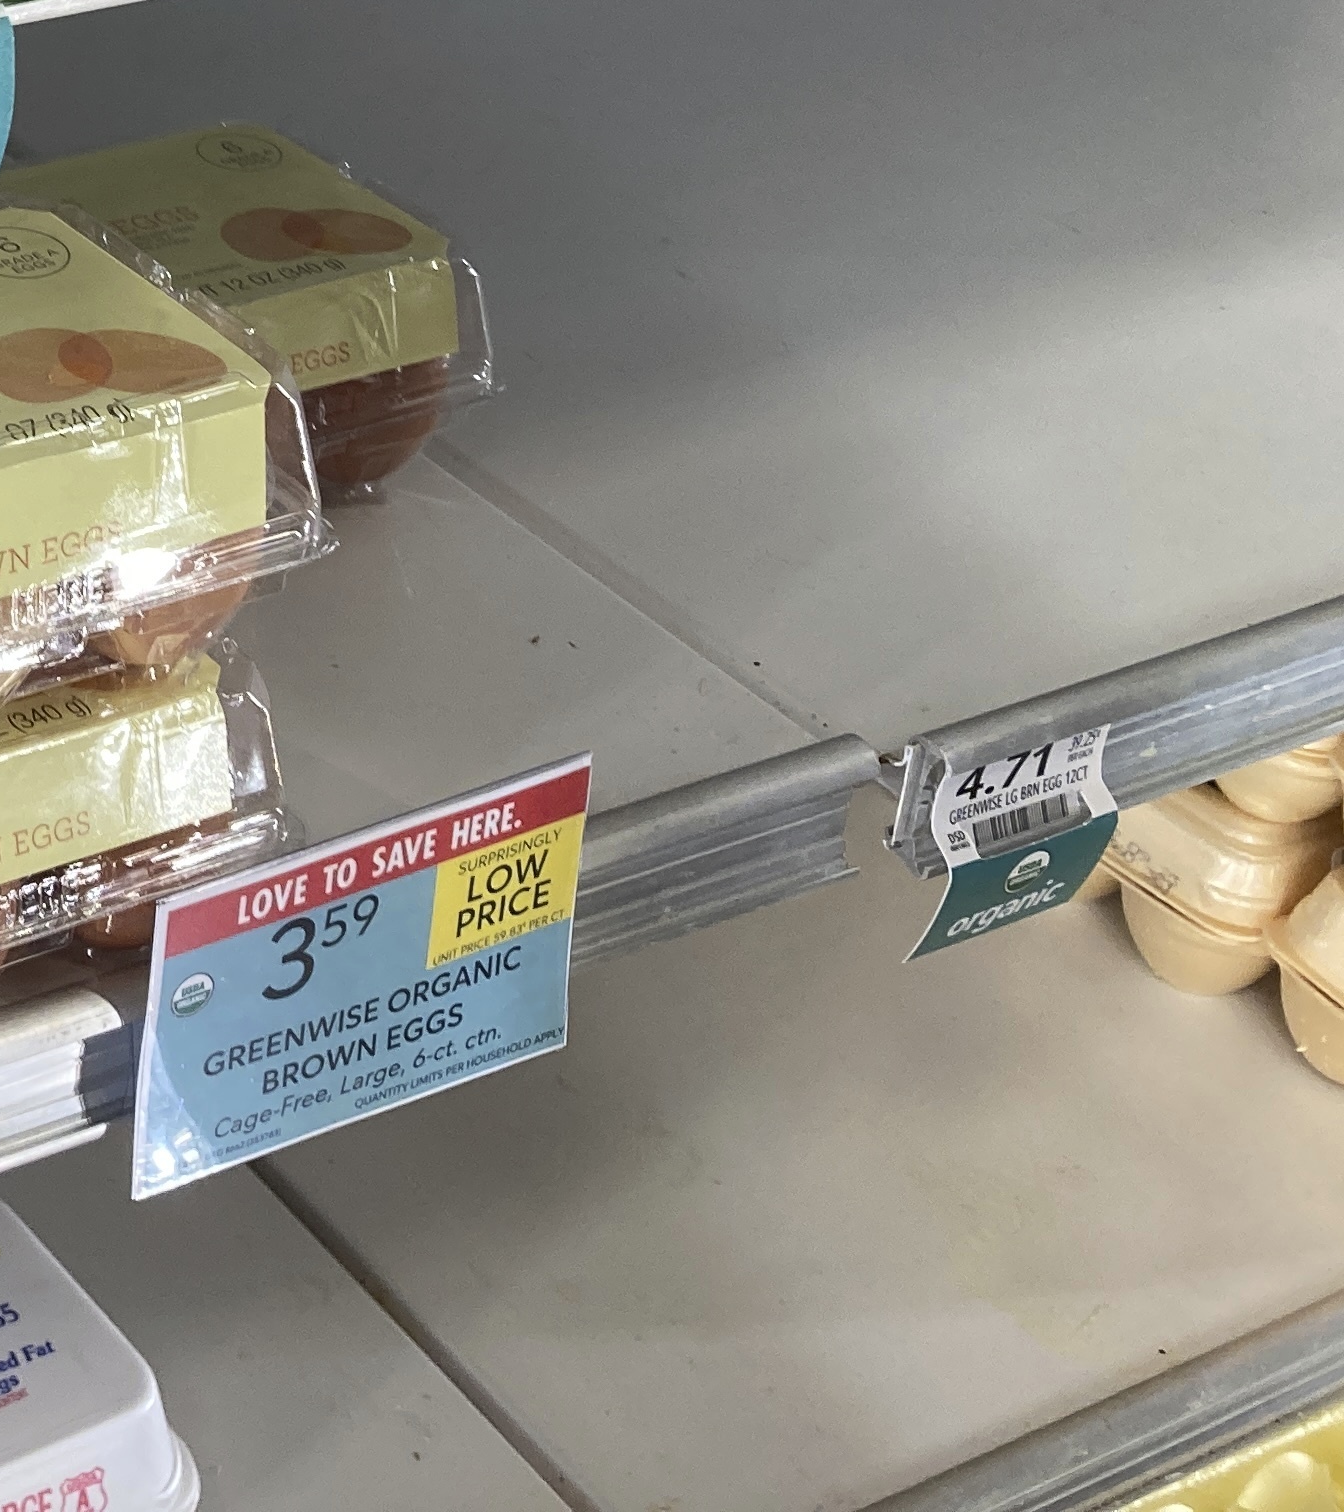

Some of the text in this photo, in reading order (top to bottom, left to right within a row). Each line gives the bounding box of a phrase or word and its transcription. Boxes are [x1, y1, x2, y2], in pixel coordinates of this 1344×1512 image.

[949, 765, 1089, 826] GREENWISE BRN EGG 12CT
[955, 742, 1055, 800] 4.71
[12, 811, 91, 858] EGGS
[236, 801, 523, 926] LOVE TO SAVE HERE.
[457, 827, 563, 876] SURPRISINGLY
[467, 848, 550, 904] LOW
[455, 877, 552, 938] PRICE
[947, 879, 1065, 937] organic
[203, 996, 380, 1078] GREENWISE
[386, 945, 522, 1015] ORGANIC
[261, 1002, 464, 1096] BROWN EGGS
[354, 1025, 566, 1110] QUANTITY LIMITS PER HOUSEHOLD APPLY
[215, 1038, 458, 1140] Cage-Free, Large, 6-ct.
